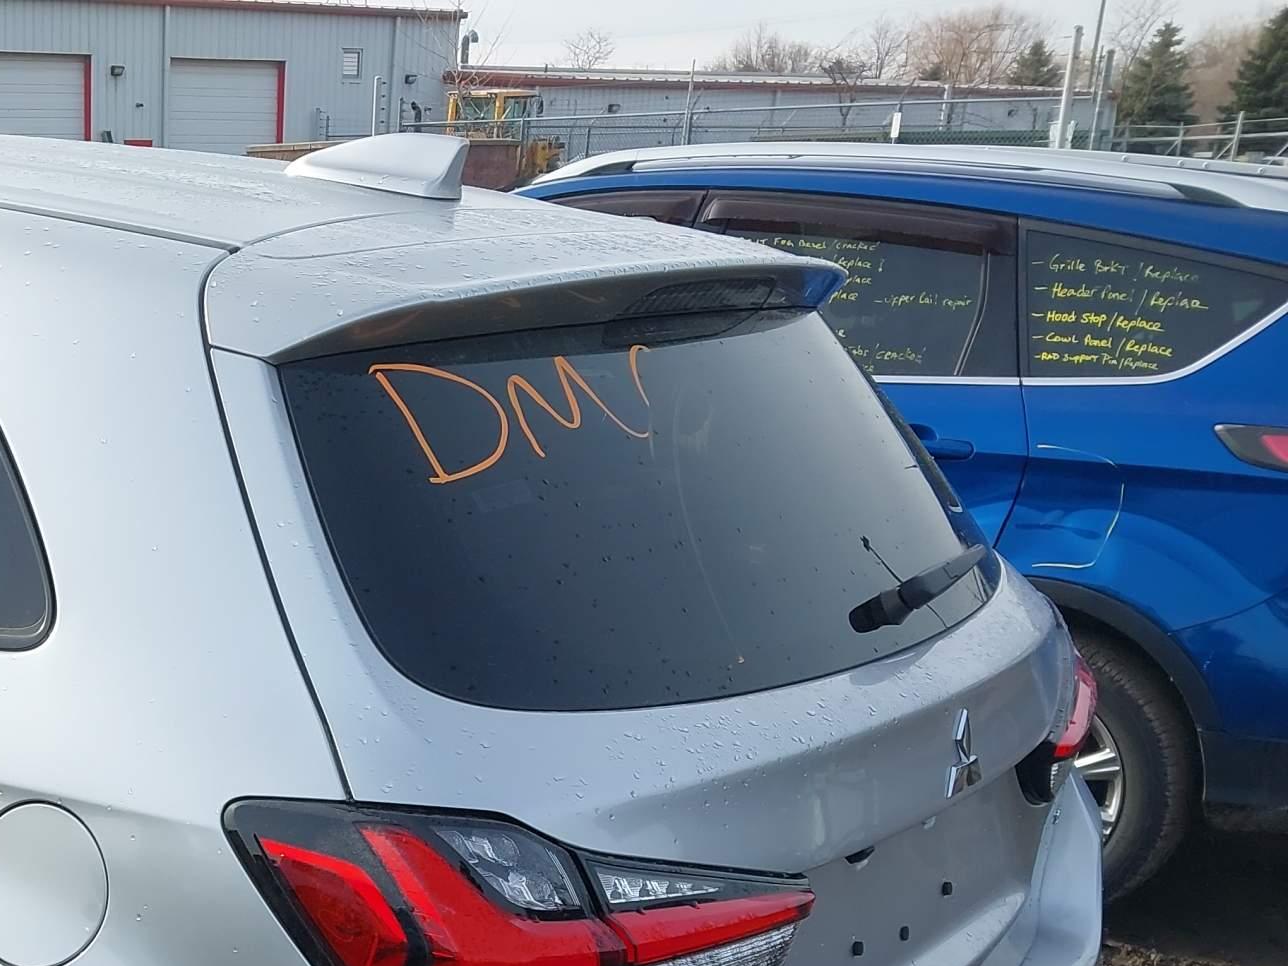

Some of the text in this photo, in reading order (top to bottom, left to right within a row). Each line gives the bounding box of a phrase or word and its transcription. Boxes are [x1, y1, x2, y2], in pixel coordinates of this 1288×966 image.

[1049, 254, 1086, 273] Grille
[1046, 310, 1076, 322] Hood
[1080, 313, 1107, 327] Stop
[1084, 334, 1112, 348] Panel
